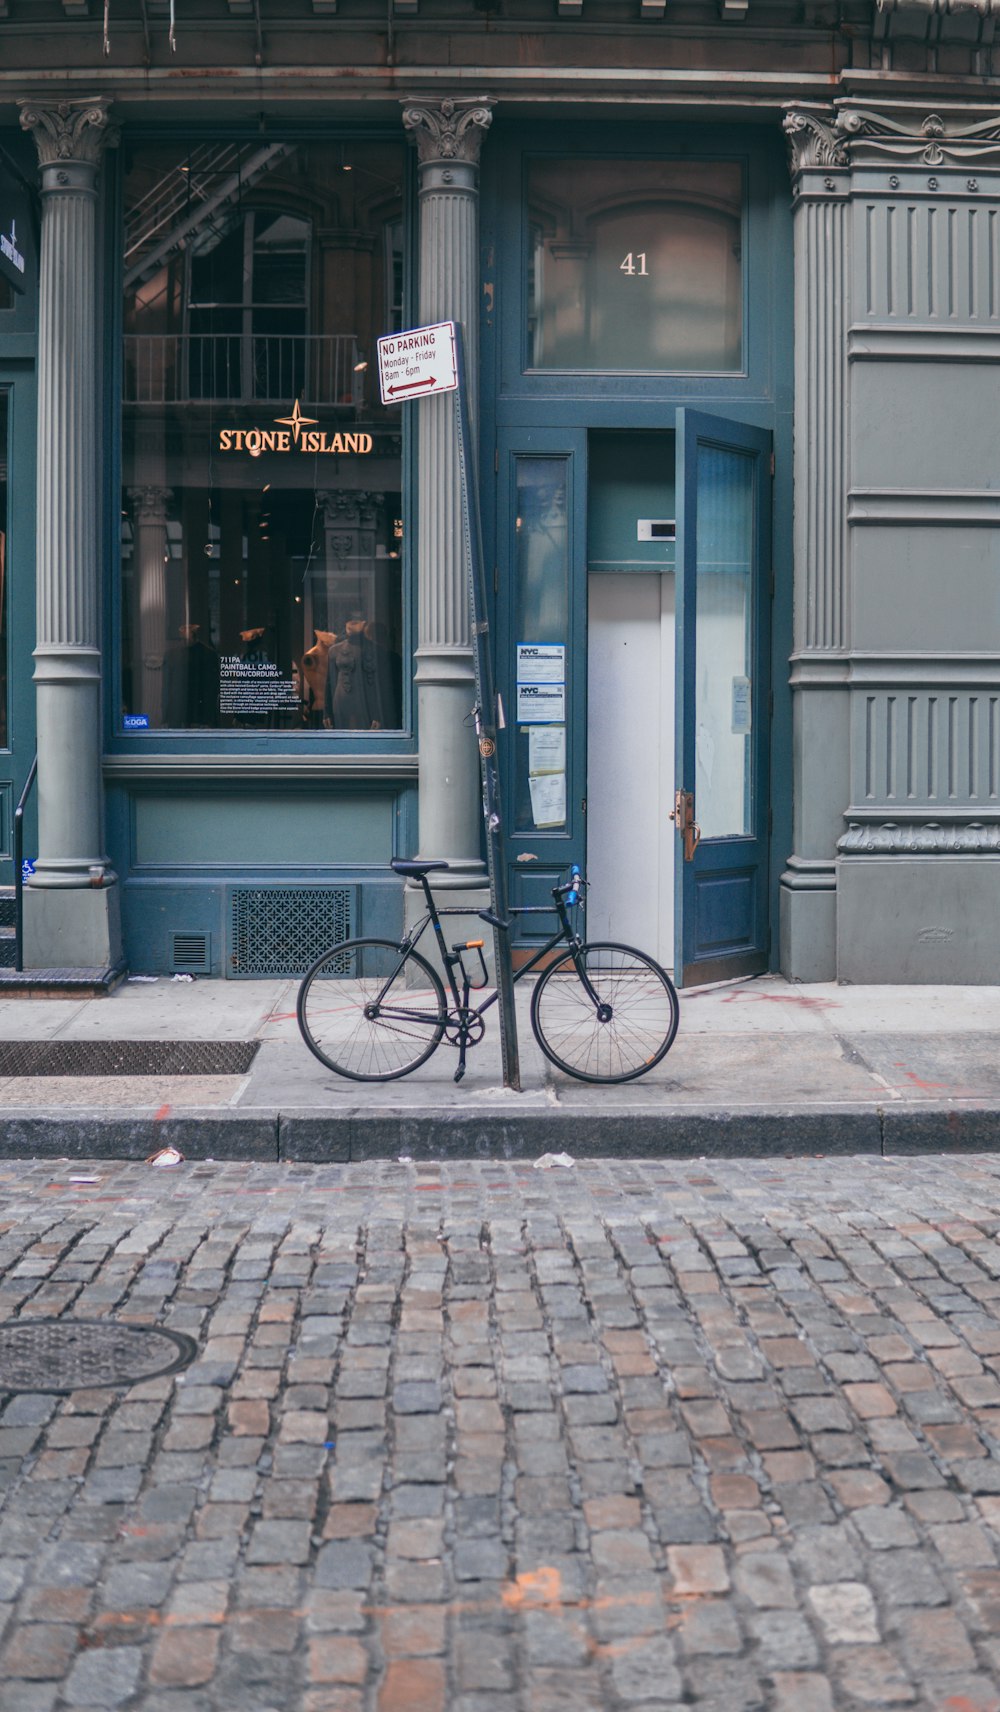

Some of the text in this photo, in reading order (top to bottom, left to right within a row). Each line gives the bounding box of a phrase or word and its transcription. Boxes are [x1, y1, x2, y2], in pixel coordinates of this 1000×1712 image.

[620, 252, 649, 275] 41
[383, 333, 435, 356] NO PARKING
[384, 357, 409, 369] Monday
[415, 350, 436, 362] Friday
[385, 371, 399, 381] 8am
[405, 366, 420, 377] 6pm
[219, 430, 373, 454] STONE ISLAND
